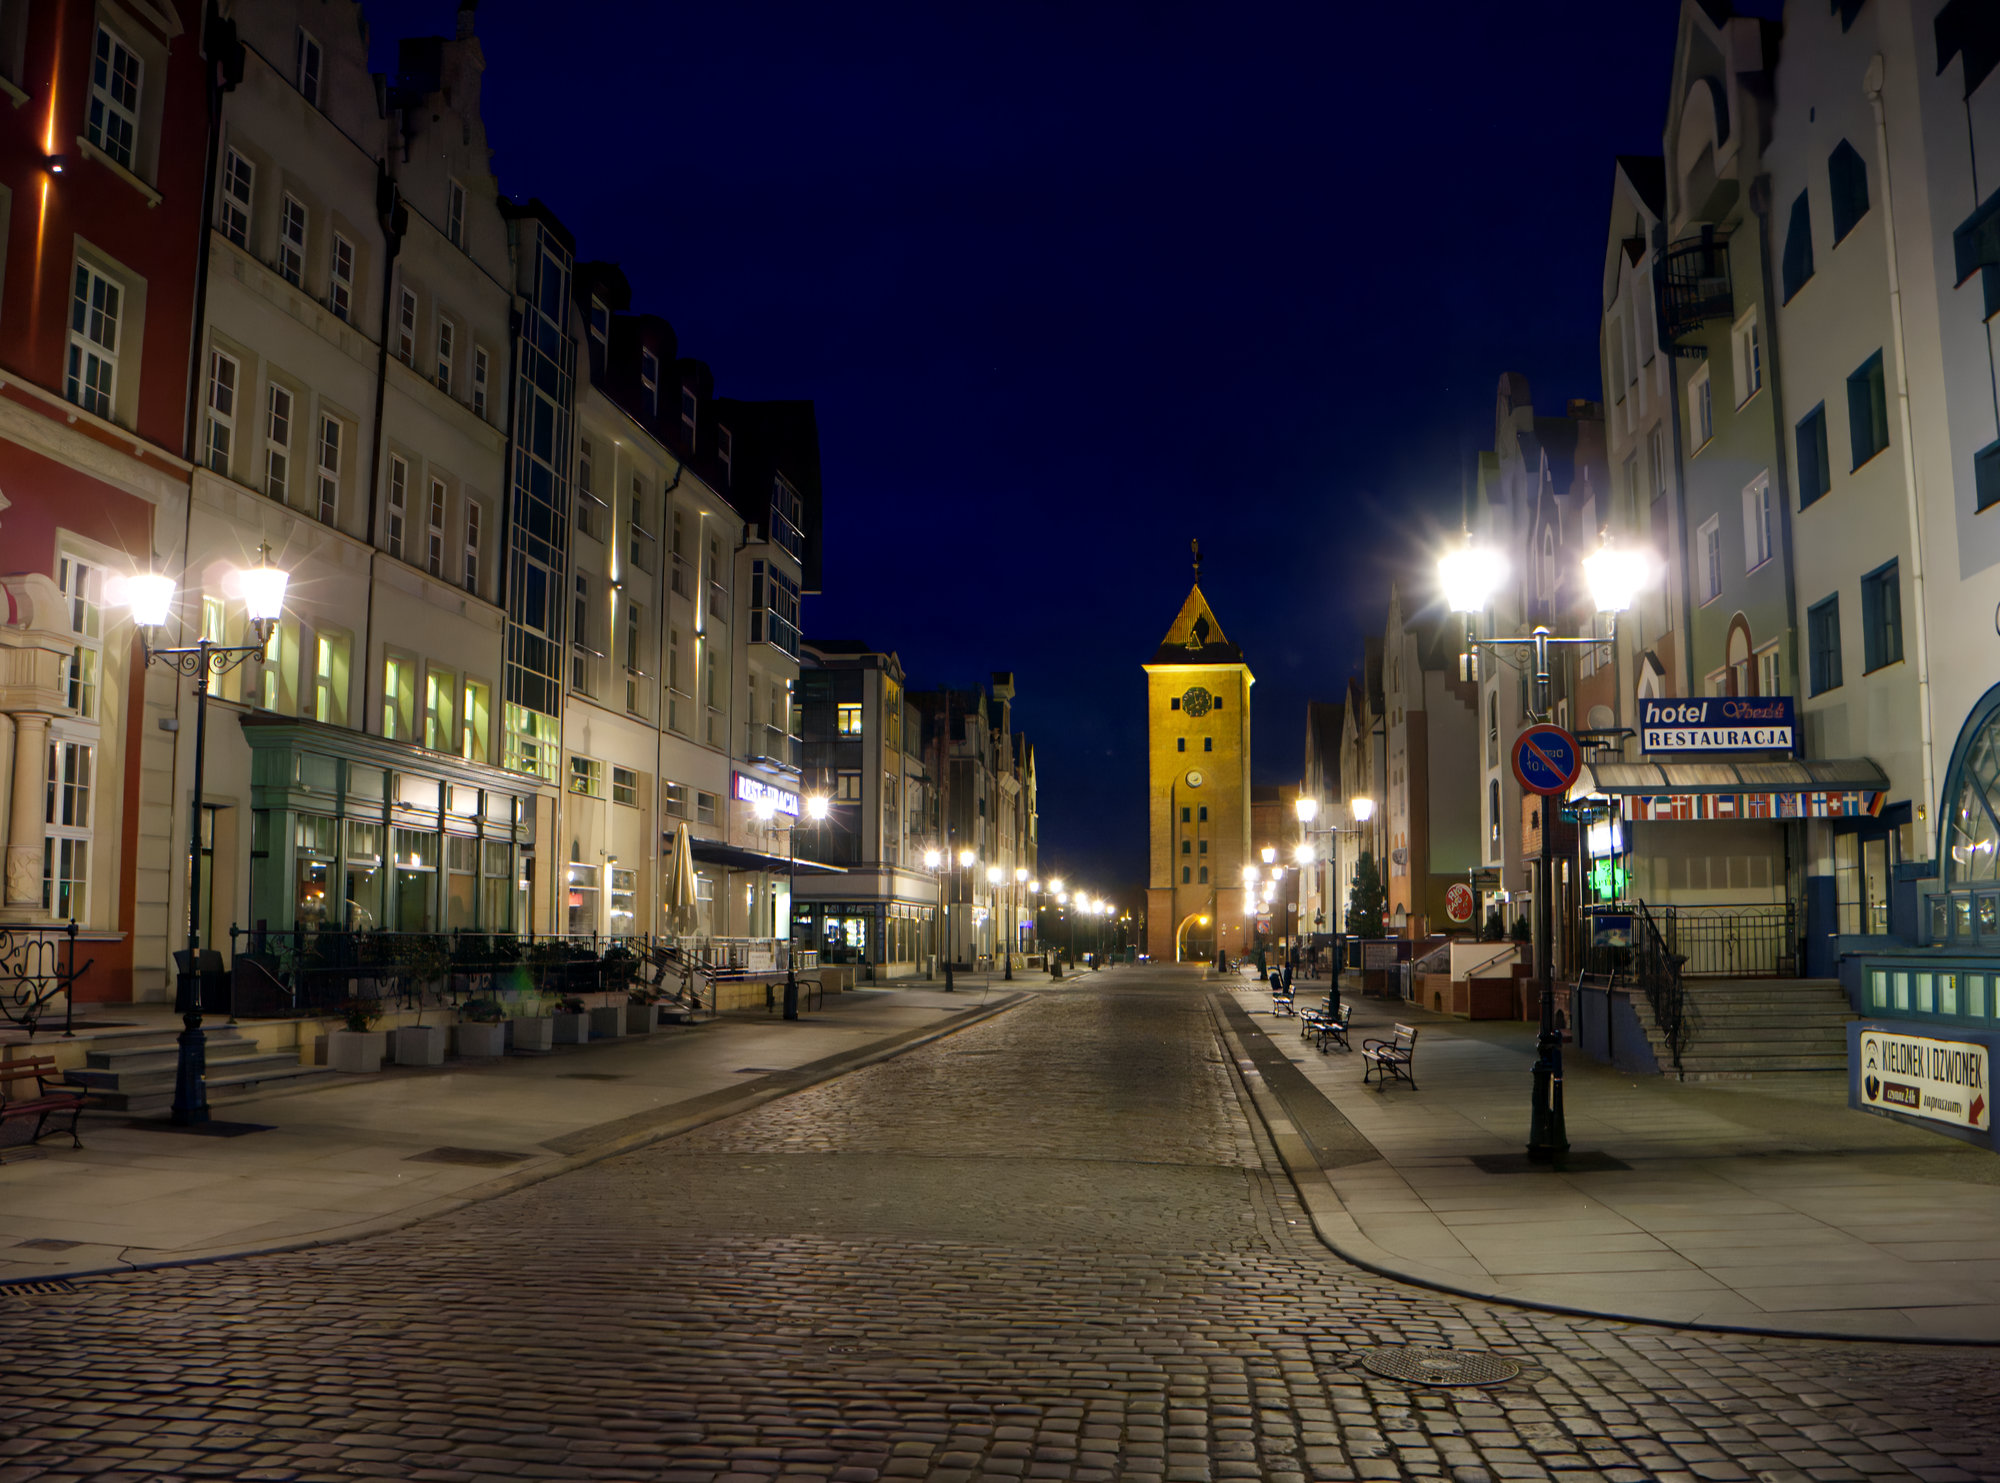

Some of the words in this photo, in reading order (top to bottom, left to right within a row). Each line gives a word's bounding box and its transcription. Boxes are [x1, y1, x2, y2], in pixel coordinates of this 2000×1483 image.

[1645, 701, 1708, 723] hotel
[1649, 730, 1789, 747] RESTAURACJA
[1882, 1040, 1924, 1078] KIELONEK
[1926, 1047, 1930, 1079] I
[1933, 1048, 1983, 1089] DZWONEK
[1923, 1094, 1962, 1117] zapraszamy
